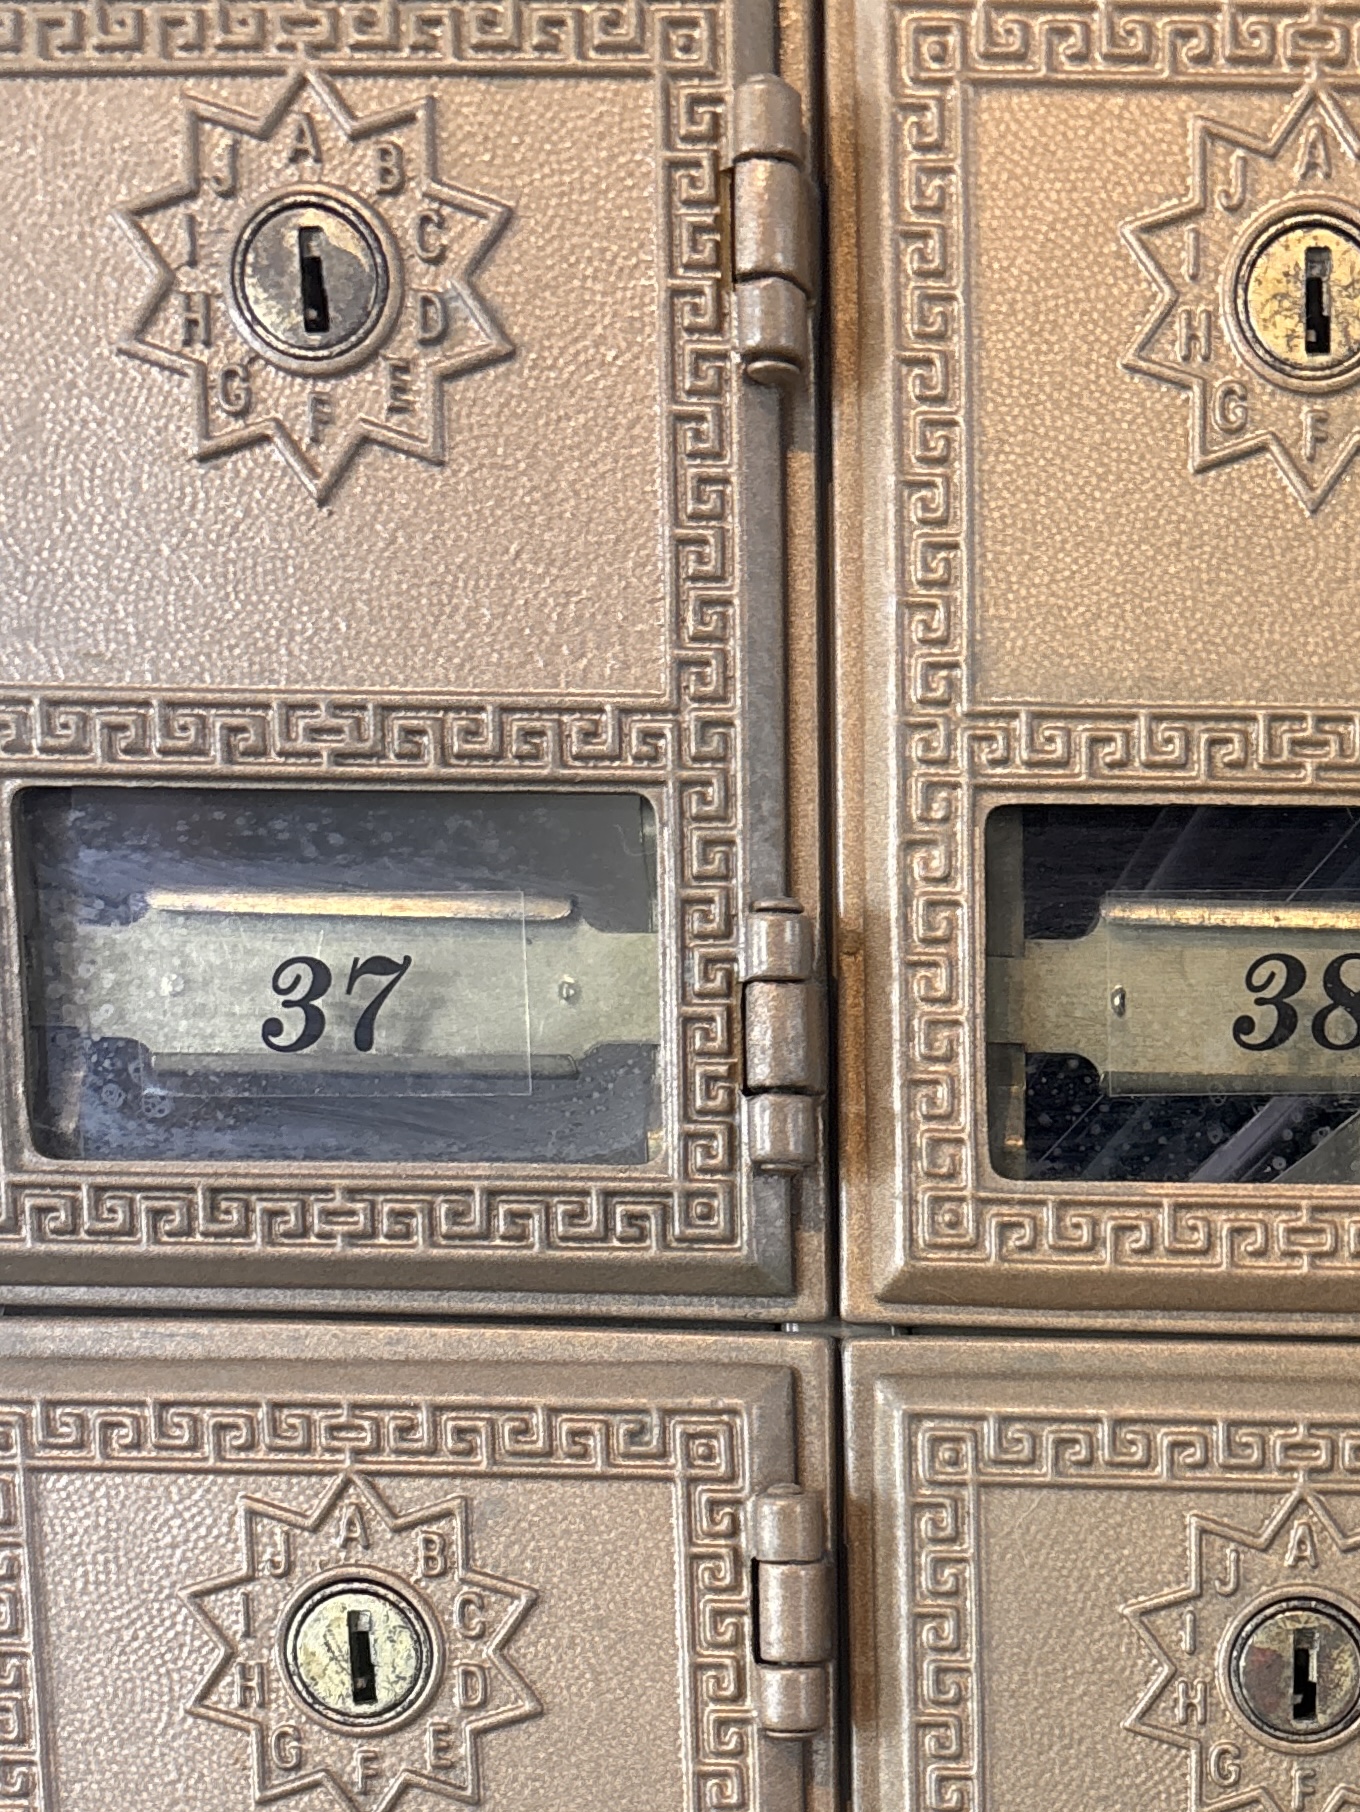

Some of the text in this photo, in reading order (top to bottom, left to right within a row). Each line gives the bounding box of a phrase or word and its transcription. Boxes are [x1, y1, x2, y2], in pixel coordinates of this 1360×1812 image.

[288, 111, 322, 163] A
[1297, 125, 1331, 180] A
[211, 140, 239, 198] J
[376, 142, 403, 196] B
[1216, 154, 1246, 210] J
[184, 214, 197, 268] I
[415, 209, 444, 265] C
[1184, 226, 1199, 281] I
[180, 296, 211, 347] H
[417, 294, 447, 345] D
[1178, 307, 1212, 361] H
[218, 363, 252, 416] G
[386, 360, 412, 413] E
[1213, 381, 1247, 433] G
[308, 392, 331, 443] F
[1303, 410, 1329, 461] F
[260, 954, 412, 1053] 37
[339, 1503, 370, 1550] A
[1285, 1522, 1317, 1568] A
[265, 1531, 291, 1578] J
[417, 1531, 447, 1577] B
[1215, 1549, 1240, 1596] J
[240, 1592, 251, 1639] I
[454, 1591, 486, 1639] C
[1182, 1609, 1196, 1655] I
[235, 1662, 265, 1708] H
[457, 1662, 488, 1709] D
[1177, 1680, 1207, 1726] H
[271, 1725, 301, 1770] G
[427, 1722, 453, 1769] E
[1209, 1741, 1242, 1787] G
[354, 1749, 379, 1794] F
[1292, 1768, 1317, 1811] F
